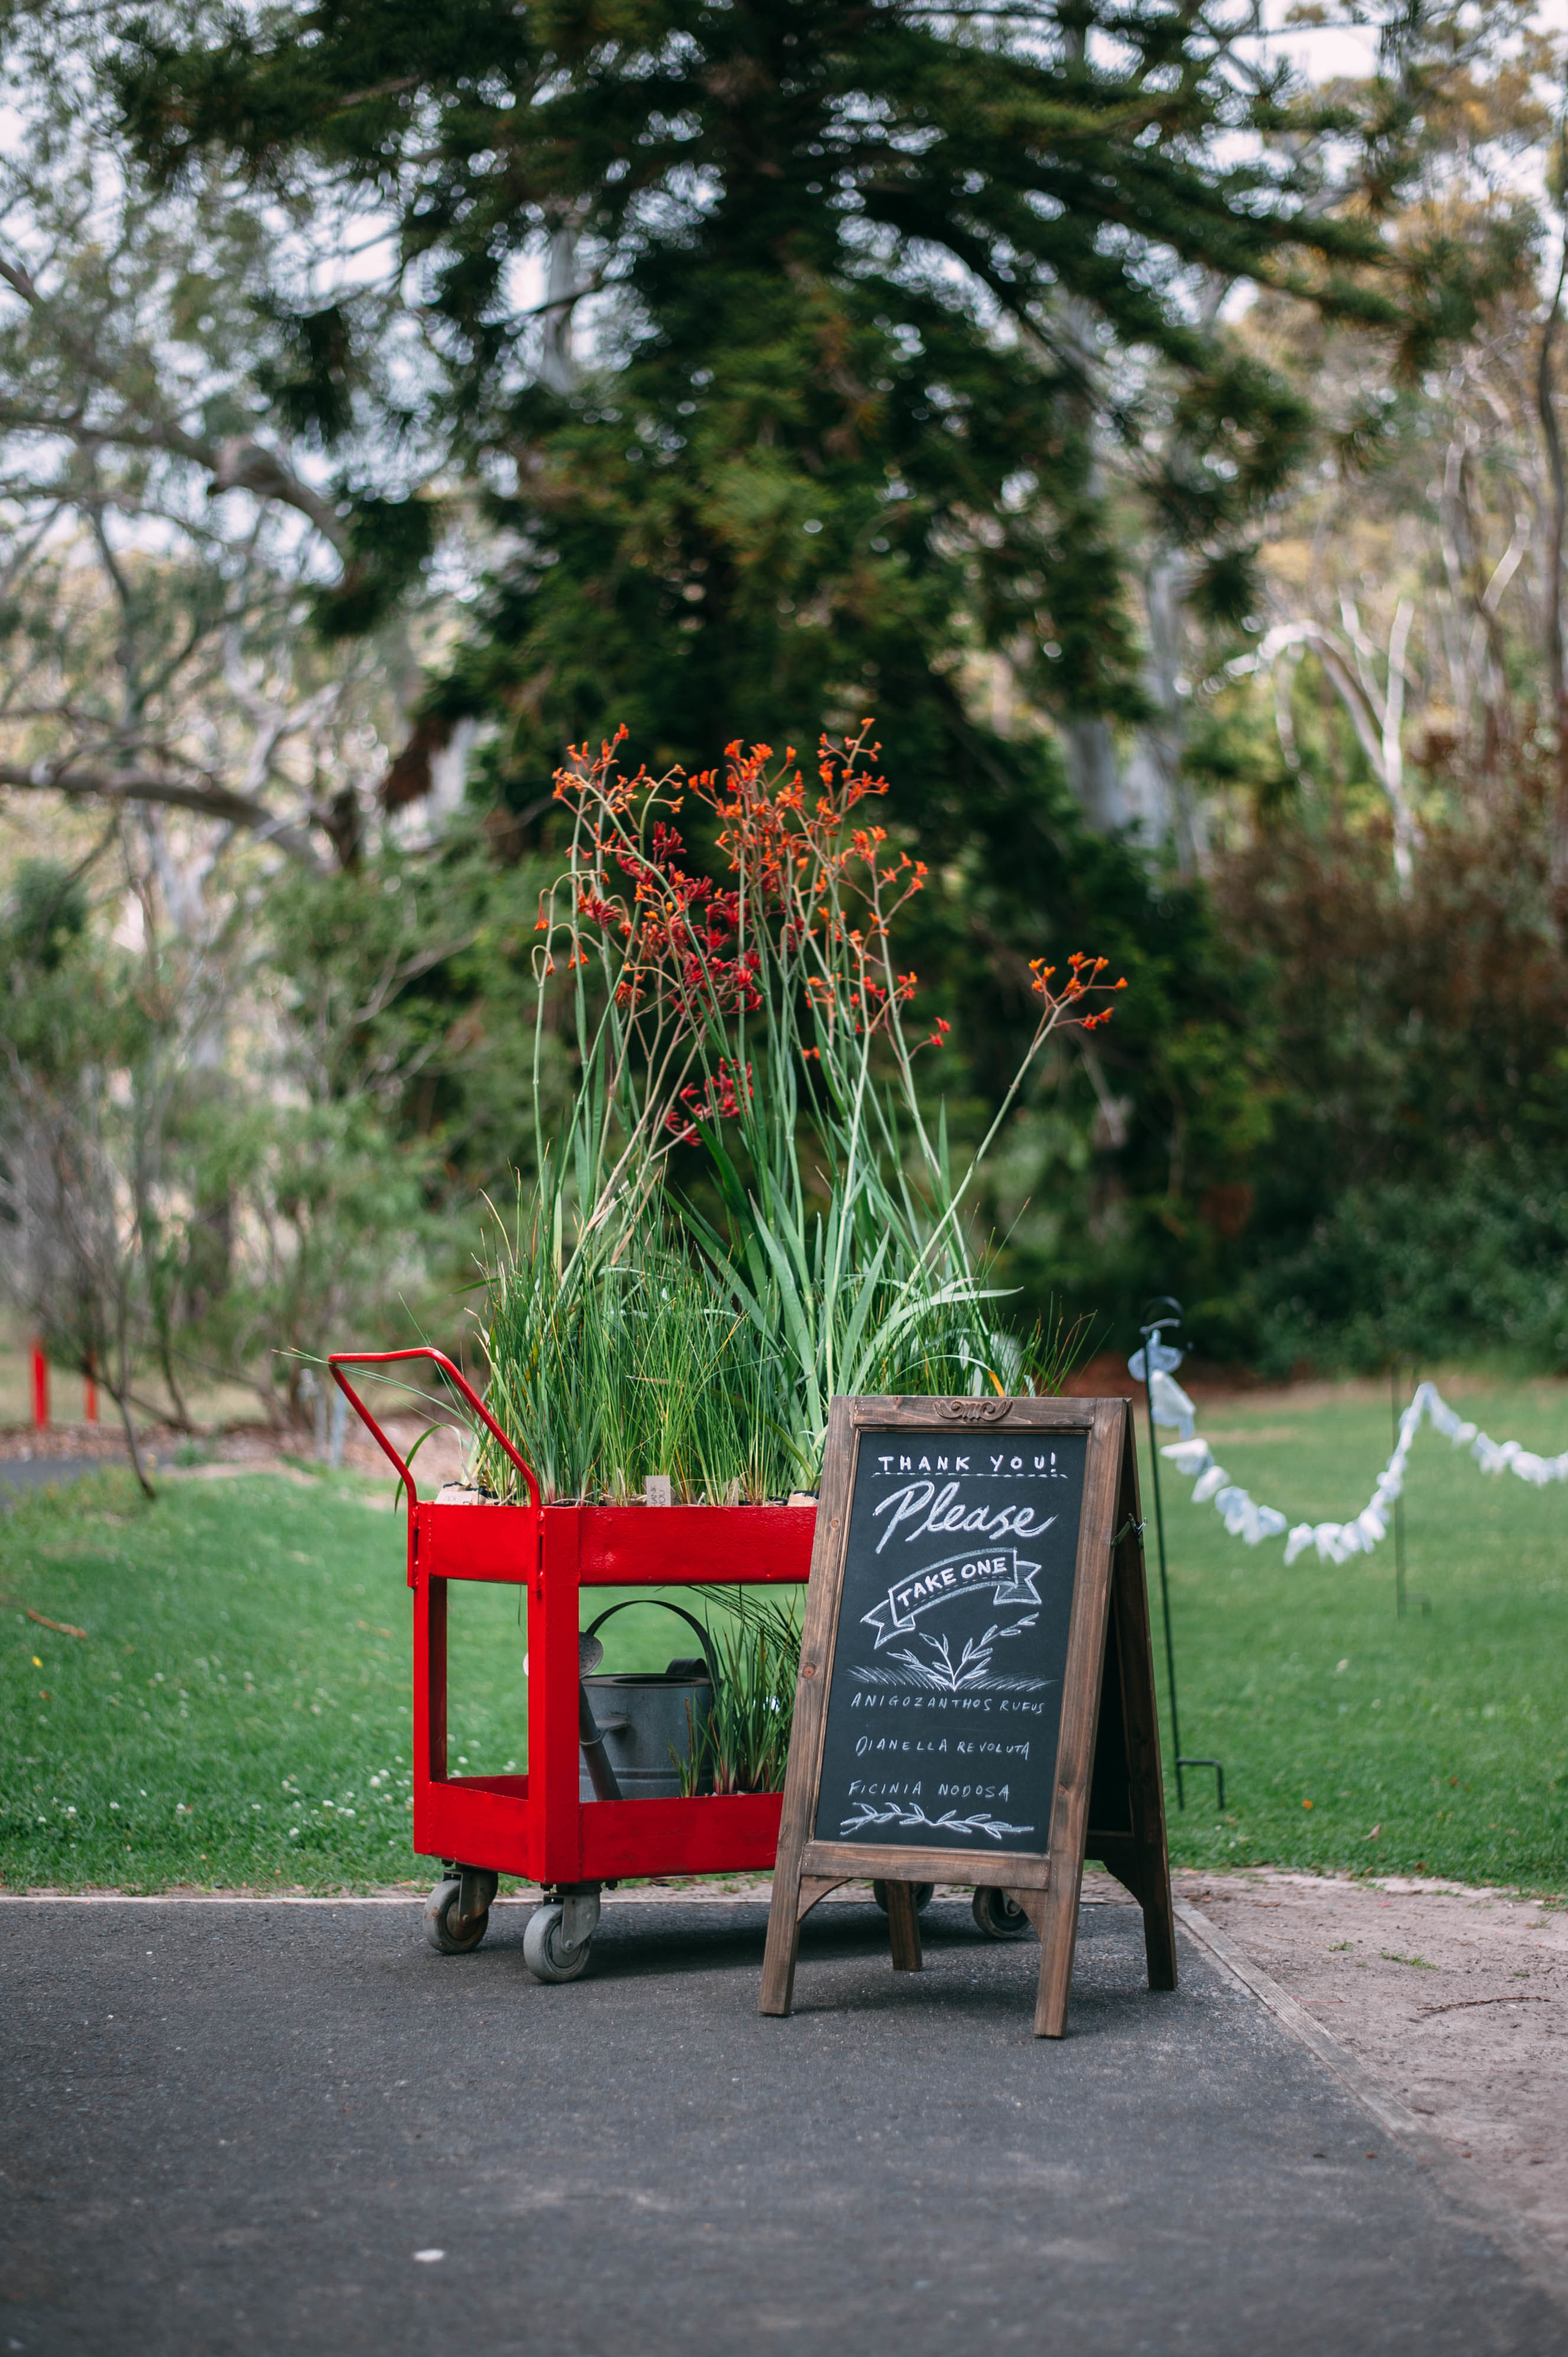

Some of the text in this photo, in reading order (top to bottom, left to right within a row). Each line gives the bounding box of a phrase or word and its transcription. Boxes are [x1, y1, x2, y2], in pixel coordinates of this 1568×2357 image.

[878, 1452, 1056, 1473] THANK YOU!
[872, 1480, 1059, 1554] Please
[897, 1557, 1007, 1607] TAKE ONE
[850, 1692, 1045, 1715] ANIGOZANTHOS RUFUS
[855, 1735, 1030, 1761] DIANELLA REVOLUTA
[848, 1780, 1010, 1802] FICINIA NODOSA
